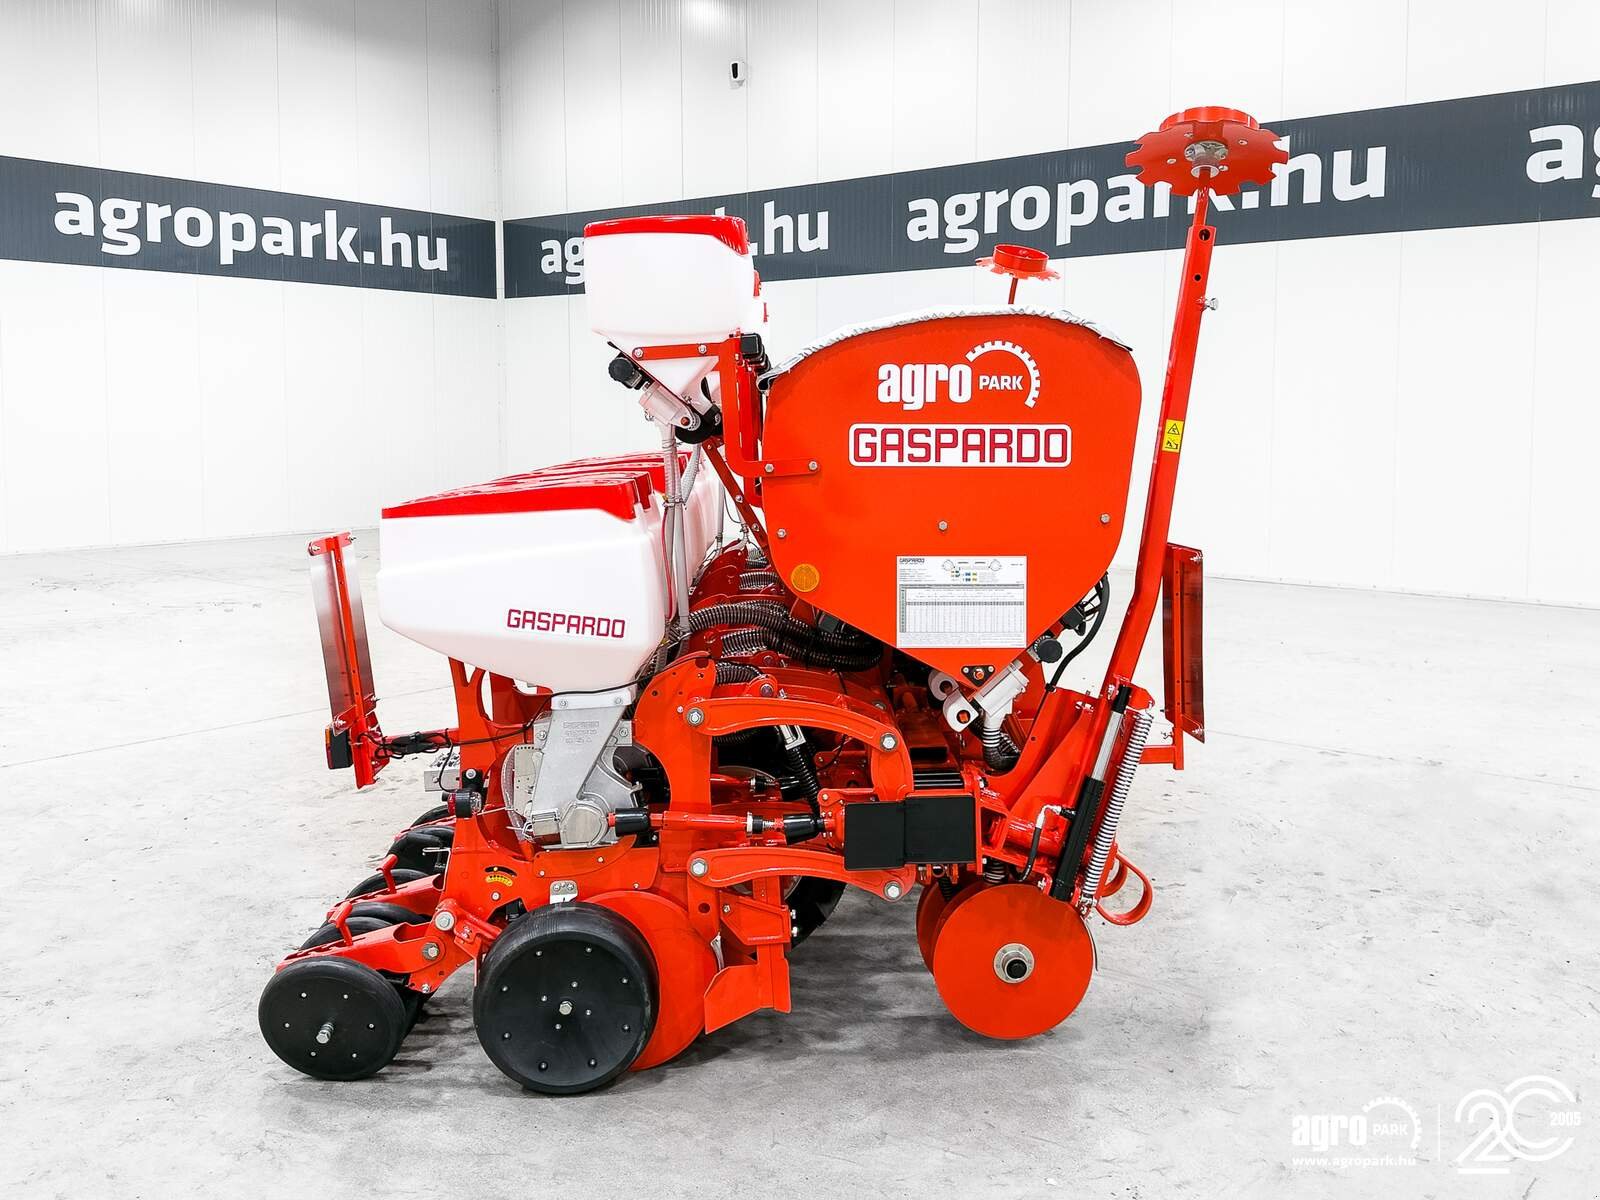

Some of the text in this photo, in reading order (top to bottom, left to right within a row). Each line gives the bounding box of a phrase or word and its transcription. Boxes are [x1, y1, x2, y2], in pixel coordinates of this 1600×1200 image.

[1526, 124, 1600, 198] a
[54, 192, 448, 271] agropark.hu
[877, 363, 1023, 411] agro PARK
[853, 428, 1068, 463] GASPARDO
[506, 609, 626, 638] GASPARDO
